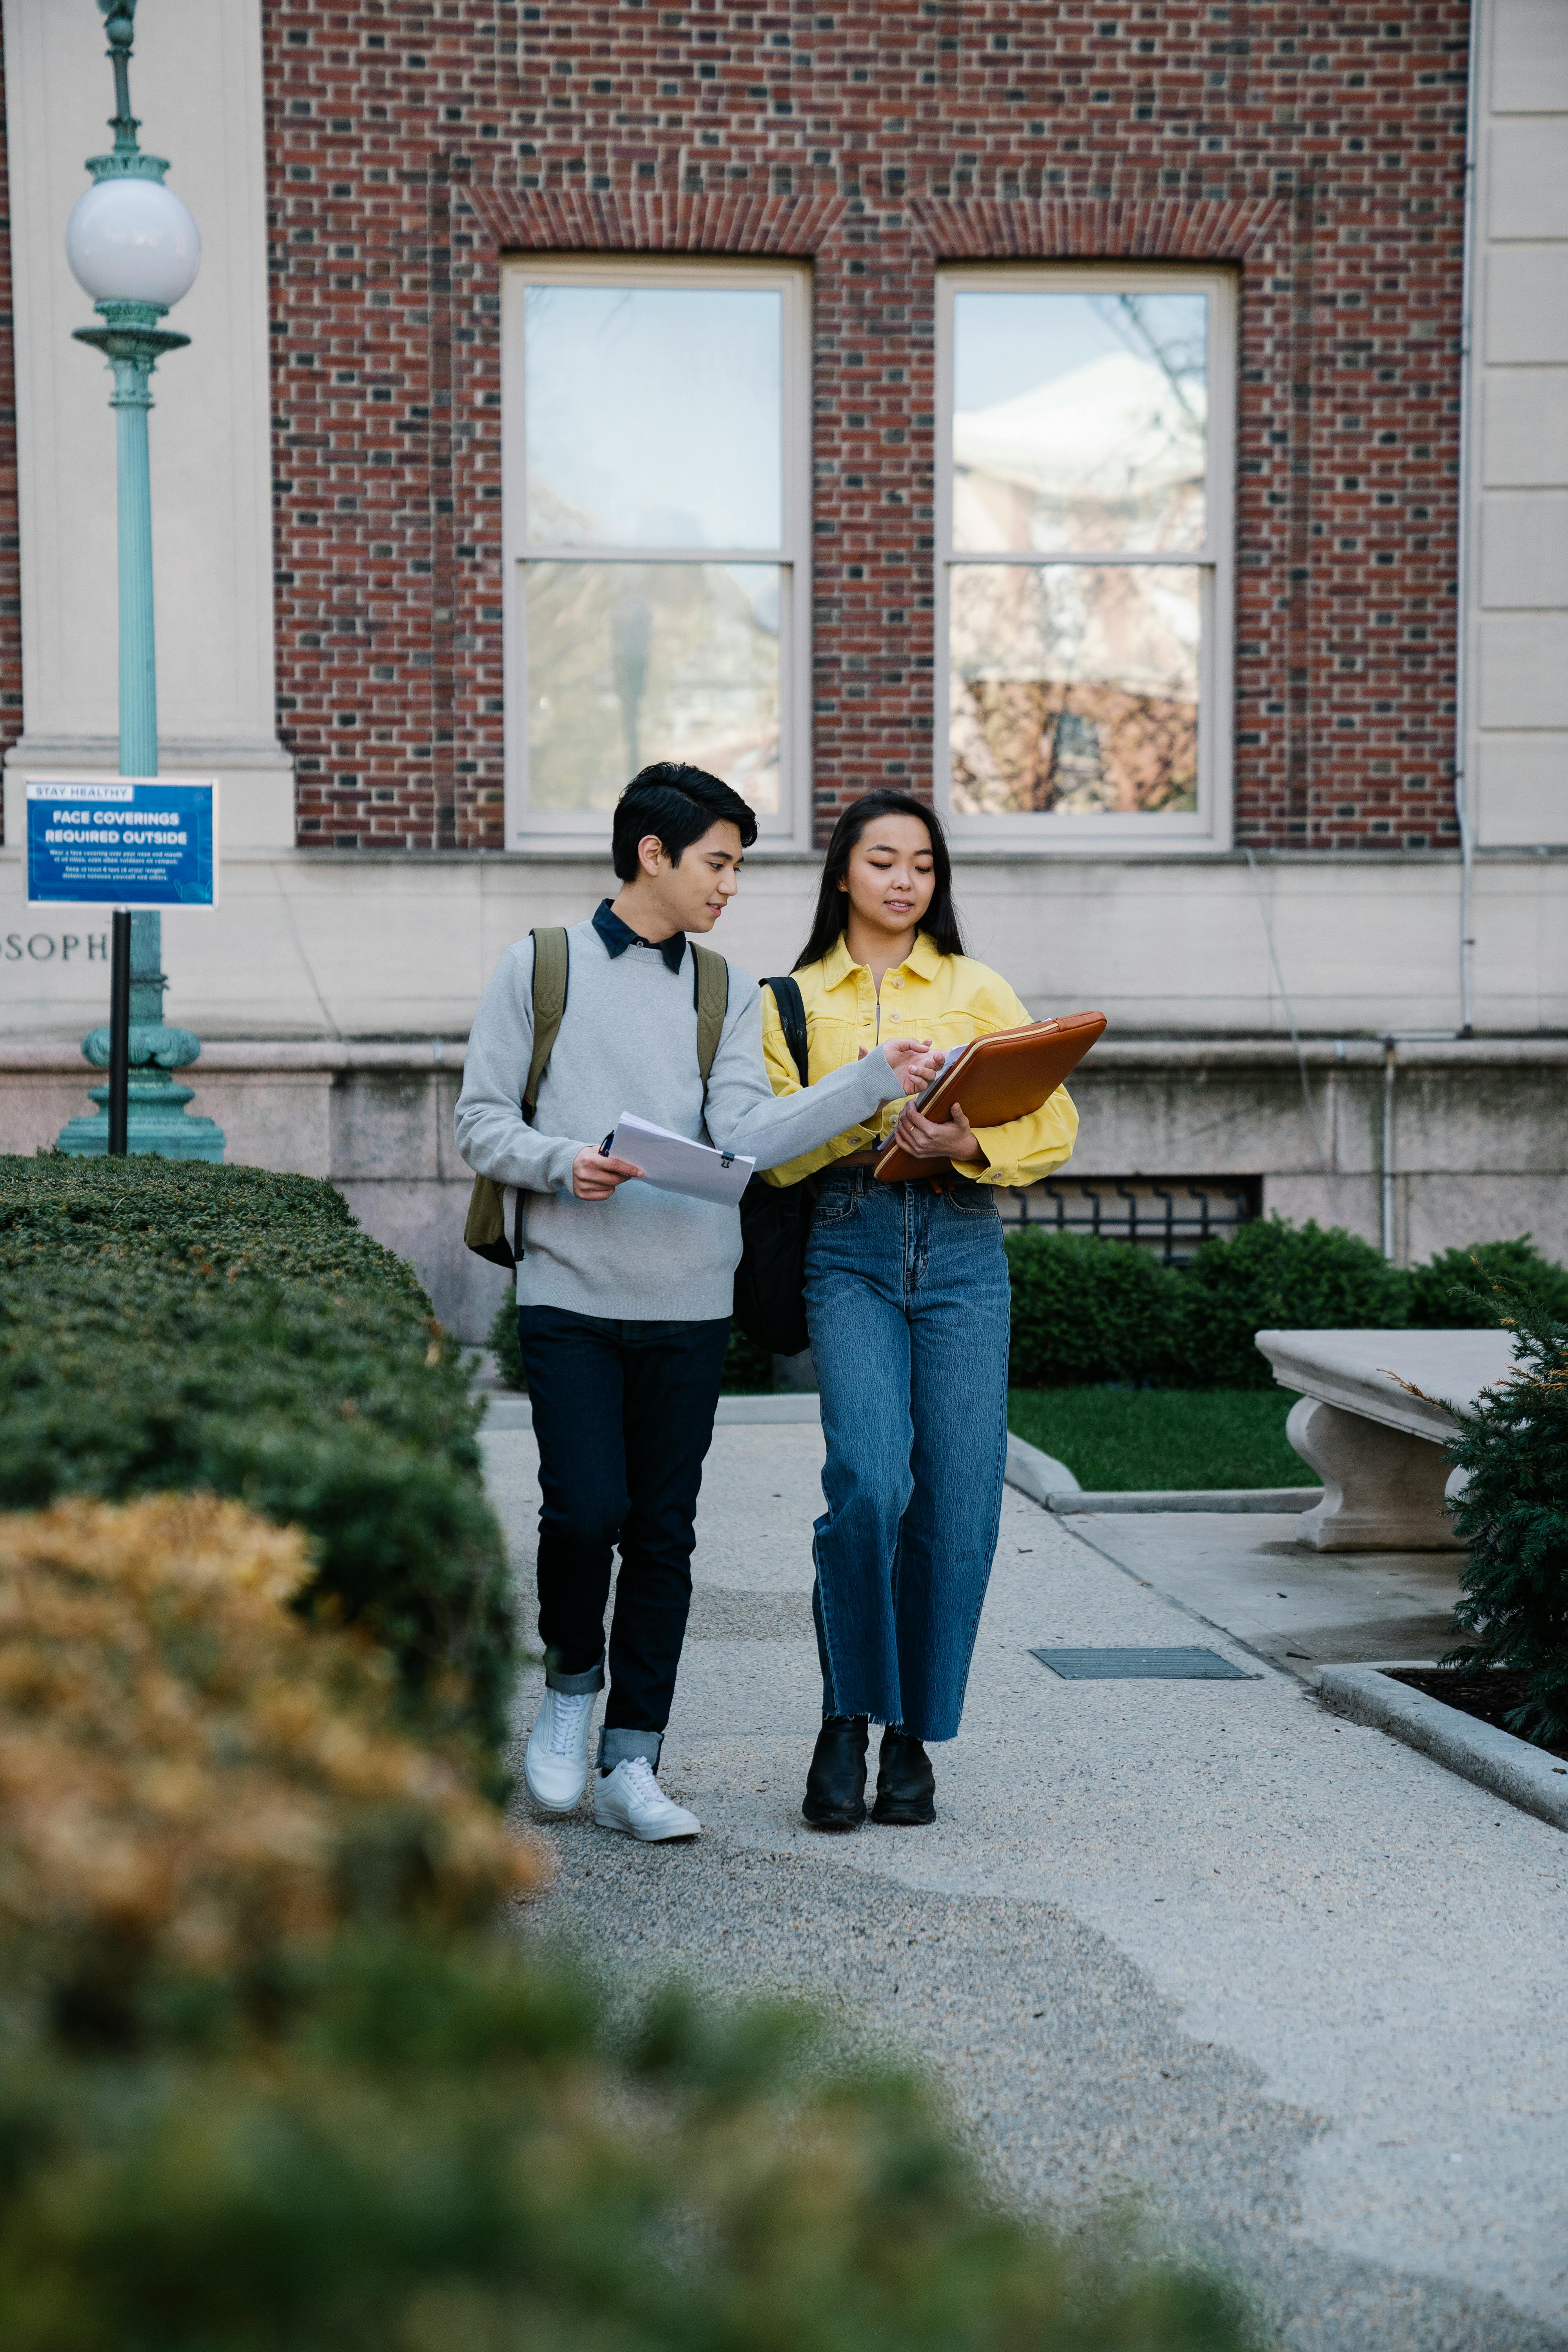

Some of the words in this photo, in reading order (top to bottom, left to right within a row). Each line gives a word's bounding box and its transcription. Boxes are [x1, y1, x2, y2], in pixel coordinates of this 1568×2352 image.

[36, 787, 65, 796] STAY
[71, 788, 127, 797] HEALTHY
[53, 810, 90, 824] FACE
[93, 811, 180, 826] COVERINGS
[45, 829, 119, 843] REQUIRED
[123, 830, 187, 845] OUTSIDE
